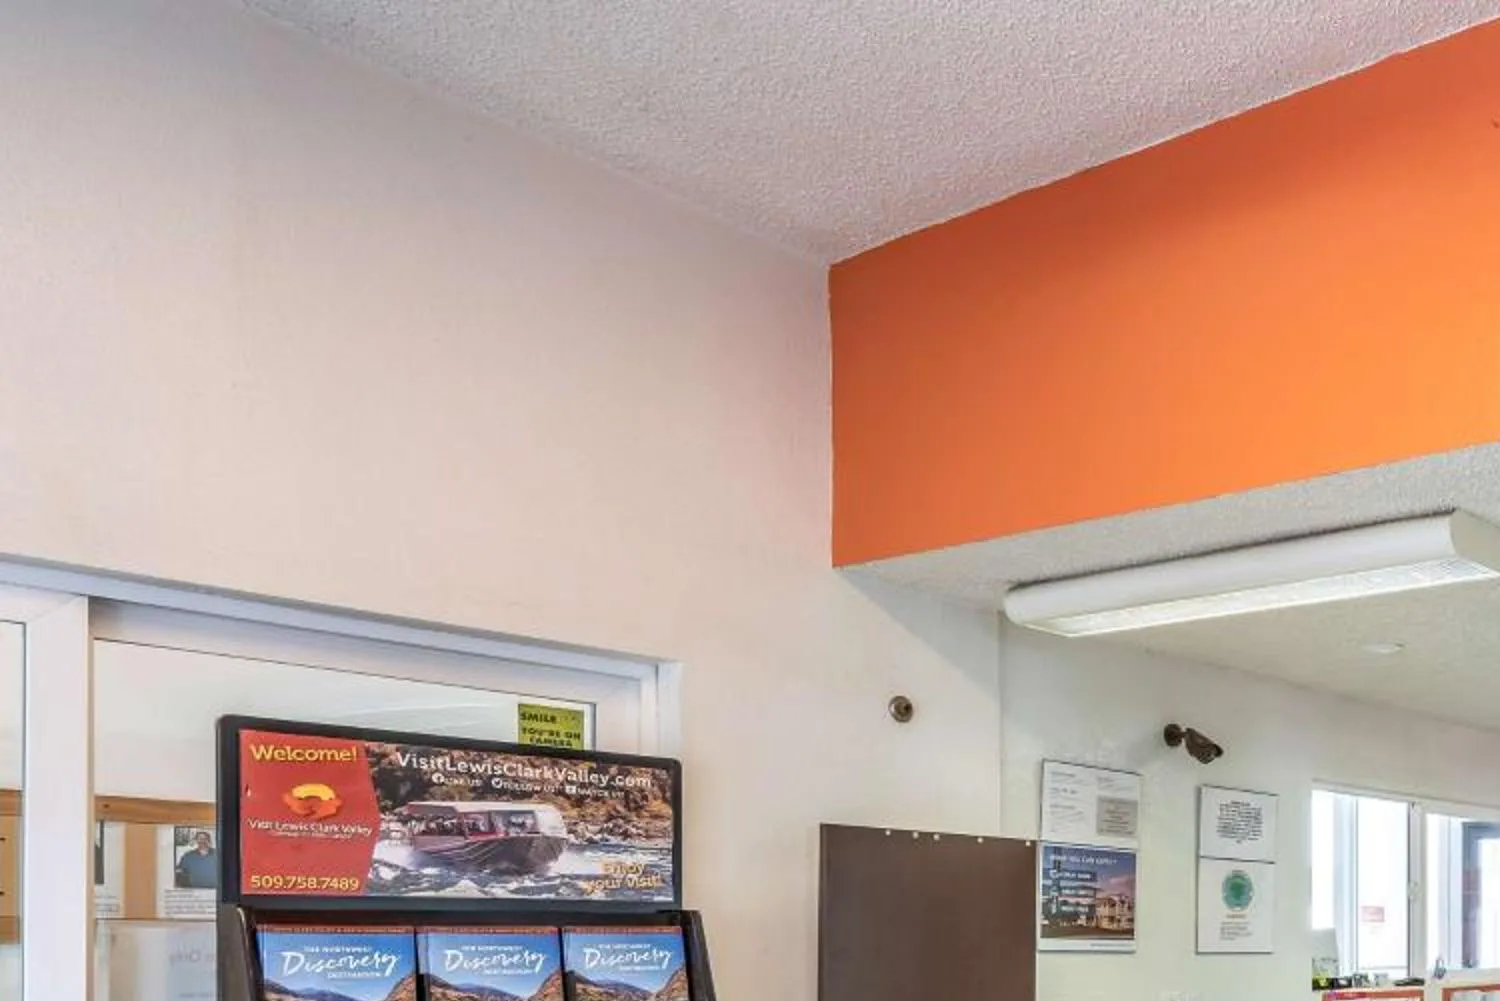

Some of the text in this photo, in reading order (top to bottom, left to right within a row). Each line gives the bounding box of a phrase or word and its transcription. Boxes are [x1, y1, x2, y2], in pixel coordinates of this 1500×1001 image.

[520, 711, 557, 724] SMILE
[251, 744, 357, 762] Welcome!
[397, 752, 652, 788] VisitLewisClarkValley.com
[248, 818, 273, 830] Visit
[275, 821, 309, 831] Lewis
[311, 823, 340, 833] Clark
[251, 875, 360, 891] 509.758.7489
[280, 950, 401, 977] Discovery
[444, 948, 547, 973] Discovery
[582, 947, 673, 970] Discovery
